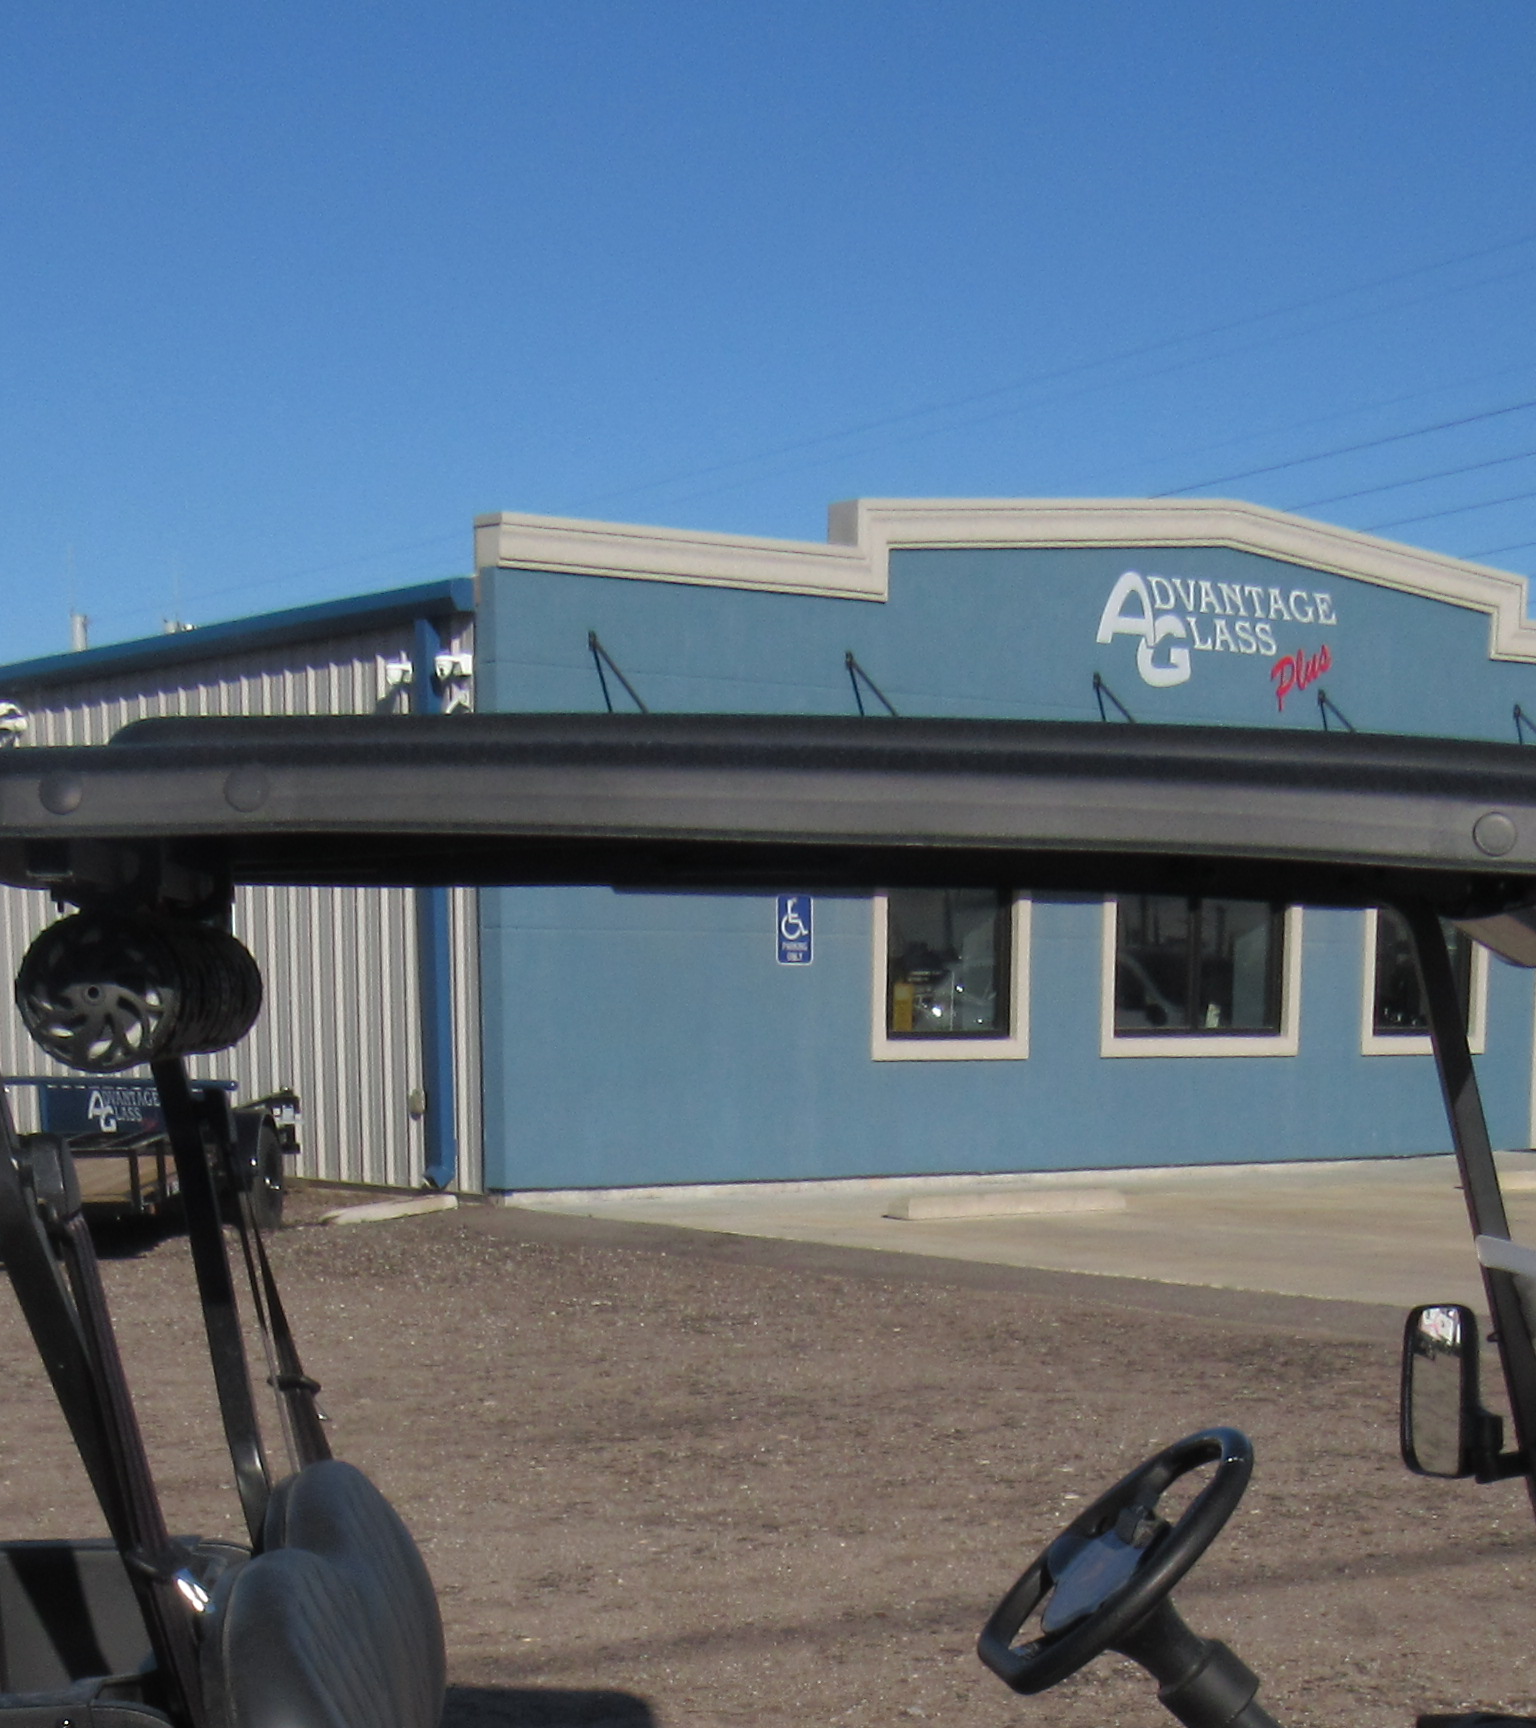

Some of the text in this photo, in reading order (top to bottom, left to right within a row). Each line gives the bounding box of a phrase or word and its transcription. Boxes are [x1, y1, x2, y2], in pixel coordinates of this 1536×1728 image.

[1096, 571, 1337, 647] ADVANTAGE
[1137, 614, 1277, 687] GLASS
[1270, 644, 1332, 712] Plus
[87, 1090, 162, 1119] ADVANTAGE
[99, 1105, 143, 1132] GLASS
